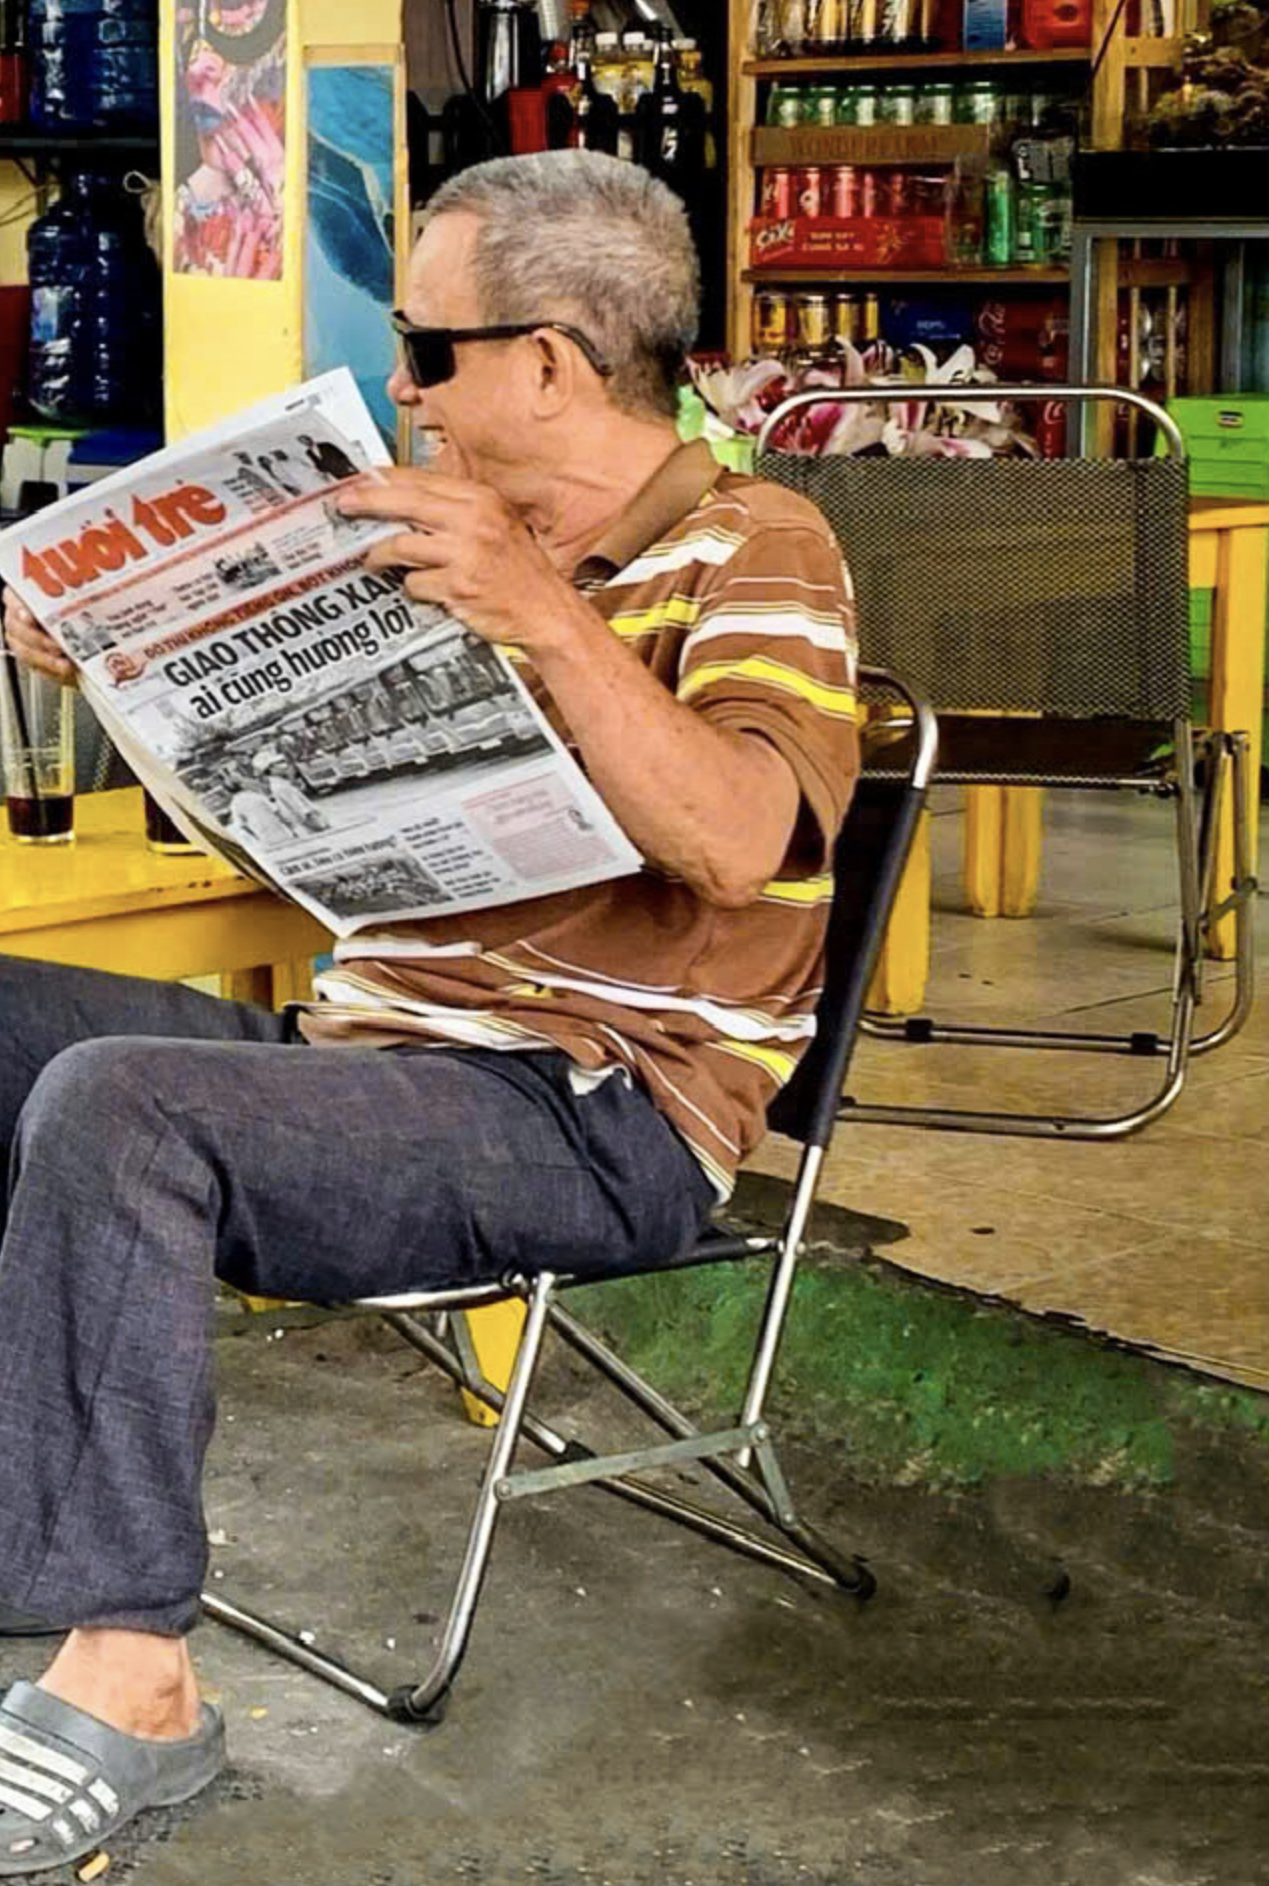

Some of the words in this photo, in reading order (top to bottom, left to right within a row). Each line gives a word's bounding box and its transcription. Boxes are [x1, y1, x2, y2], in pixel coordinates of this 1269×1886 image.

[132, 479, 228, 547] trẻ
[163, 641, 239, 688] GIAO
[233, 594, 345, 650] THÔNG
[189, 678, 222, 719] ai
[221, 656, 292, 705] cũng
[286, 620, 379, 680] hưởng
